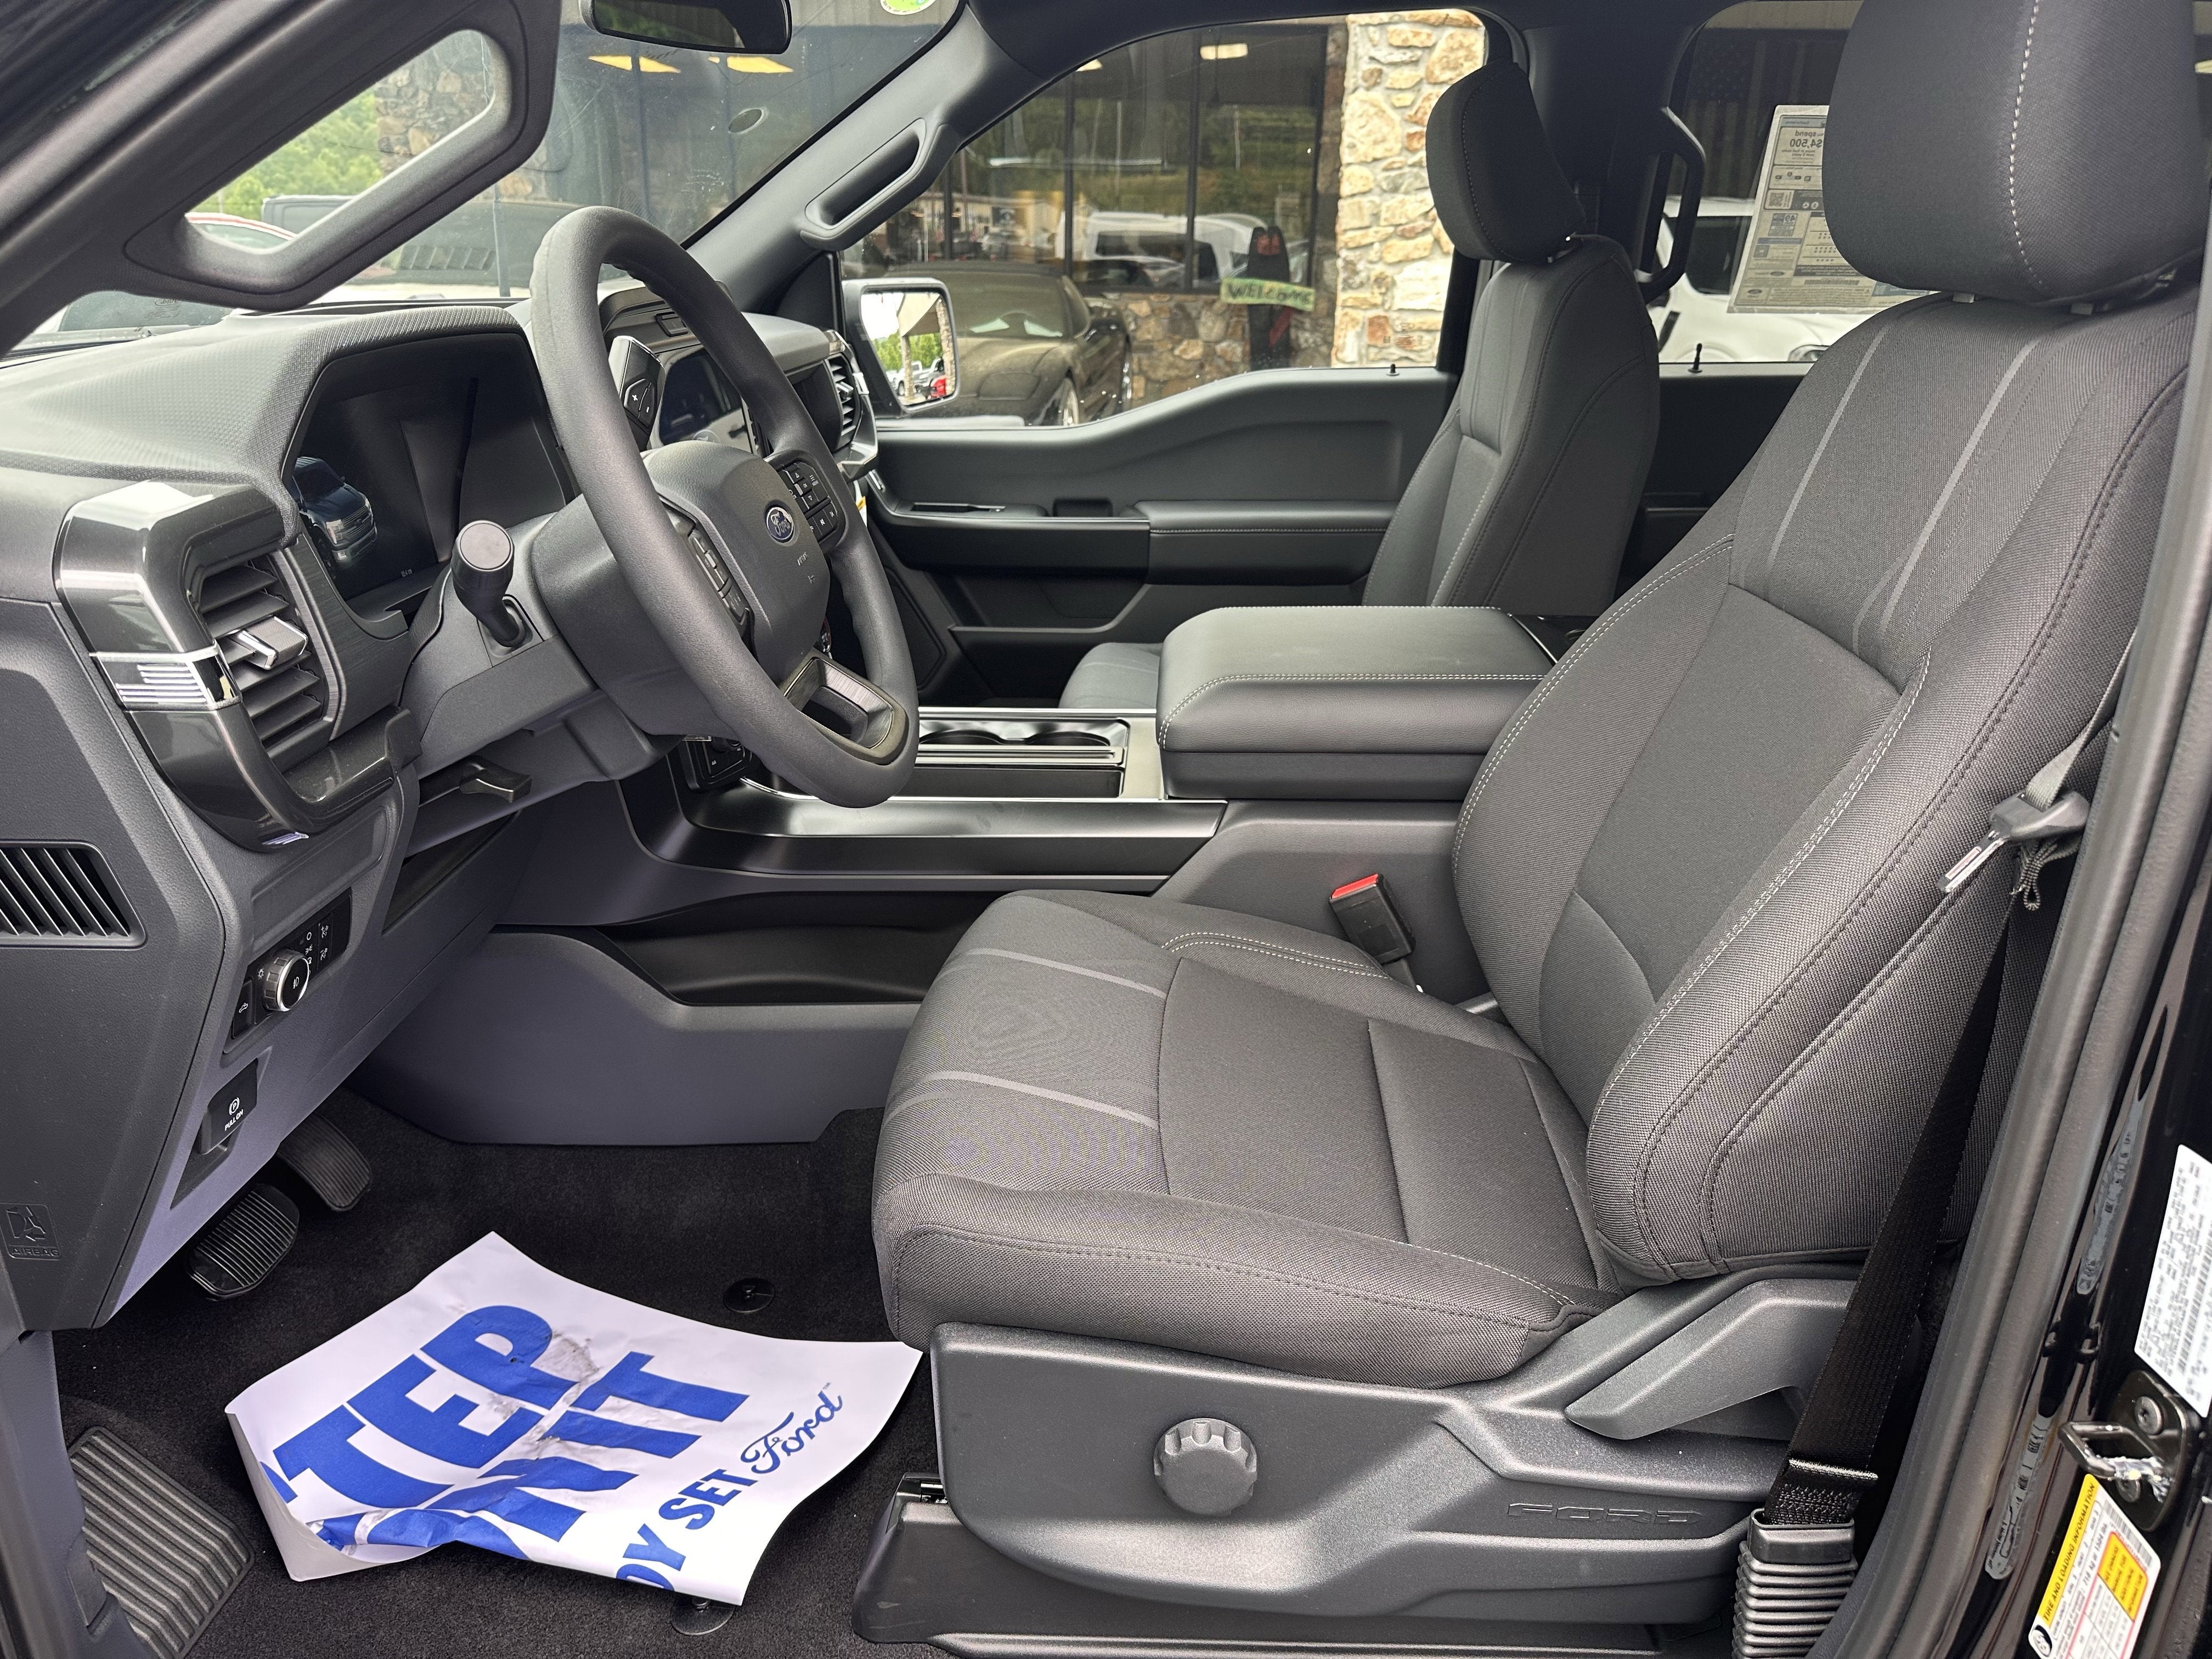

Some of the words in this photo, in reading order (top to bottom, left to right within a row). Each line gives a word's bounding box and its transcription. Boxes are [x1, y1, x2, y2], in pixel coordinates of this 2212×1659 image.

[770, 511, 791, 537] Ford
[224, 1117, 236, 1131] PULL
[235, 1109, 244, 1120] ON
[12, 1247, 60, 1257] AIRBAG
[658, 1469, 758, 1530] SET
[740, 1390, 843, 1474] Ford
[1508, 1503, 1703, 1525] FORD
[2042, 1599, 2054, 1622] TIRE
[2051, 1581, 2061, 1602] AND
[2057, 1542, 2074, 1583] LOADING
[2070, 1483, 2095, 1544] INFORMATION
